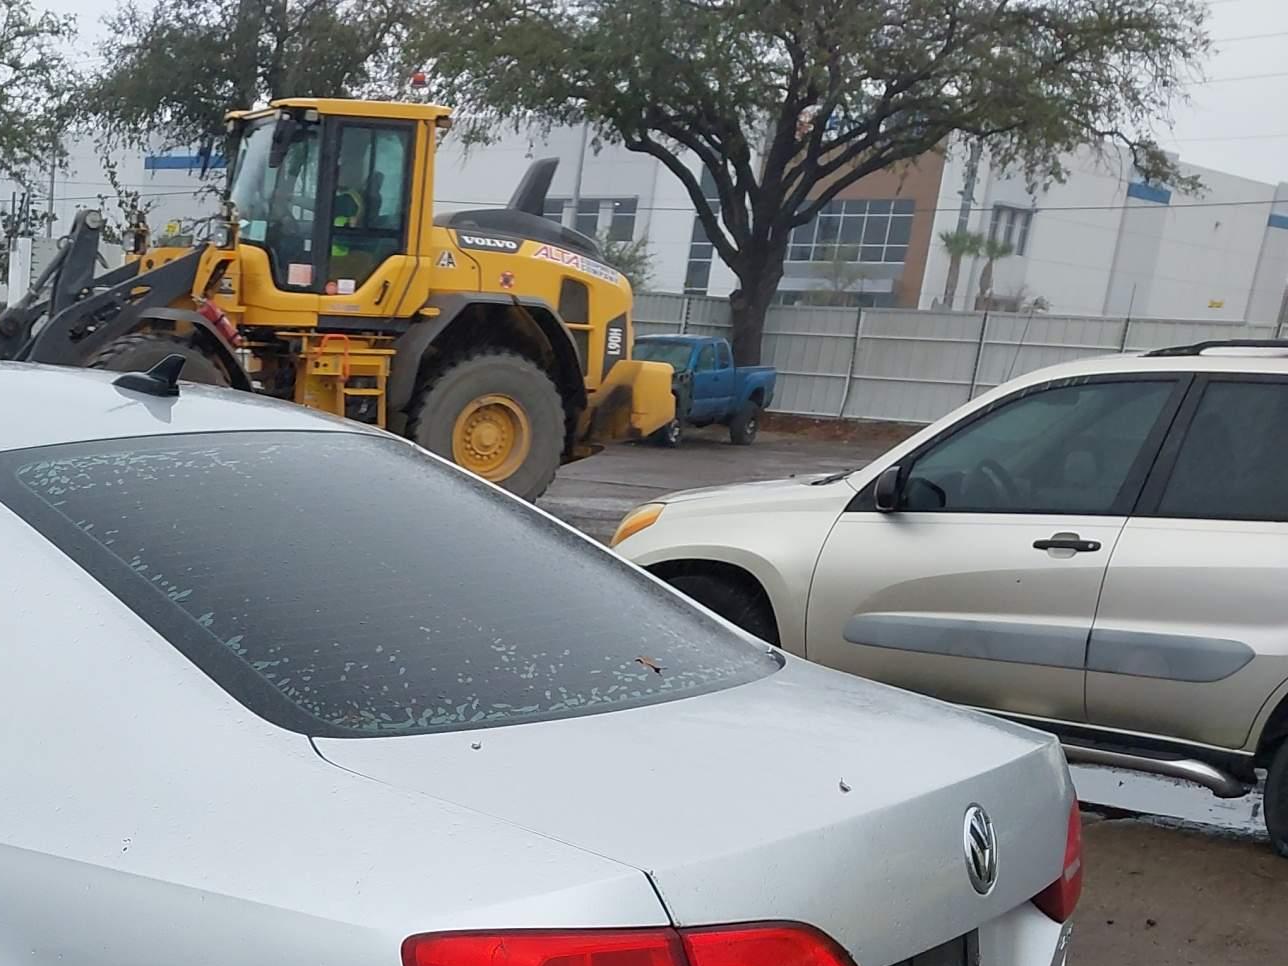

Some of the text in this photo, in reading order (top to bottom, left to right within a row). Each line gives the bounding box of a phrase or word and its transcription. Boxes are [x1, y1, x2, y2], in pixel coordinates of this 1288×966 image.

[462, 235, 517, 249] VOLVO
[533, 245, 582, 268] ALTA
[607, 327, 623, 355] L90H
